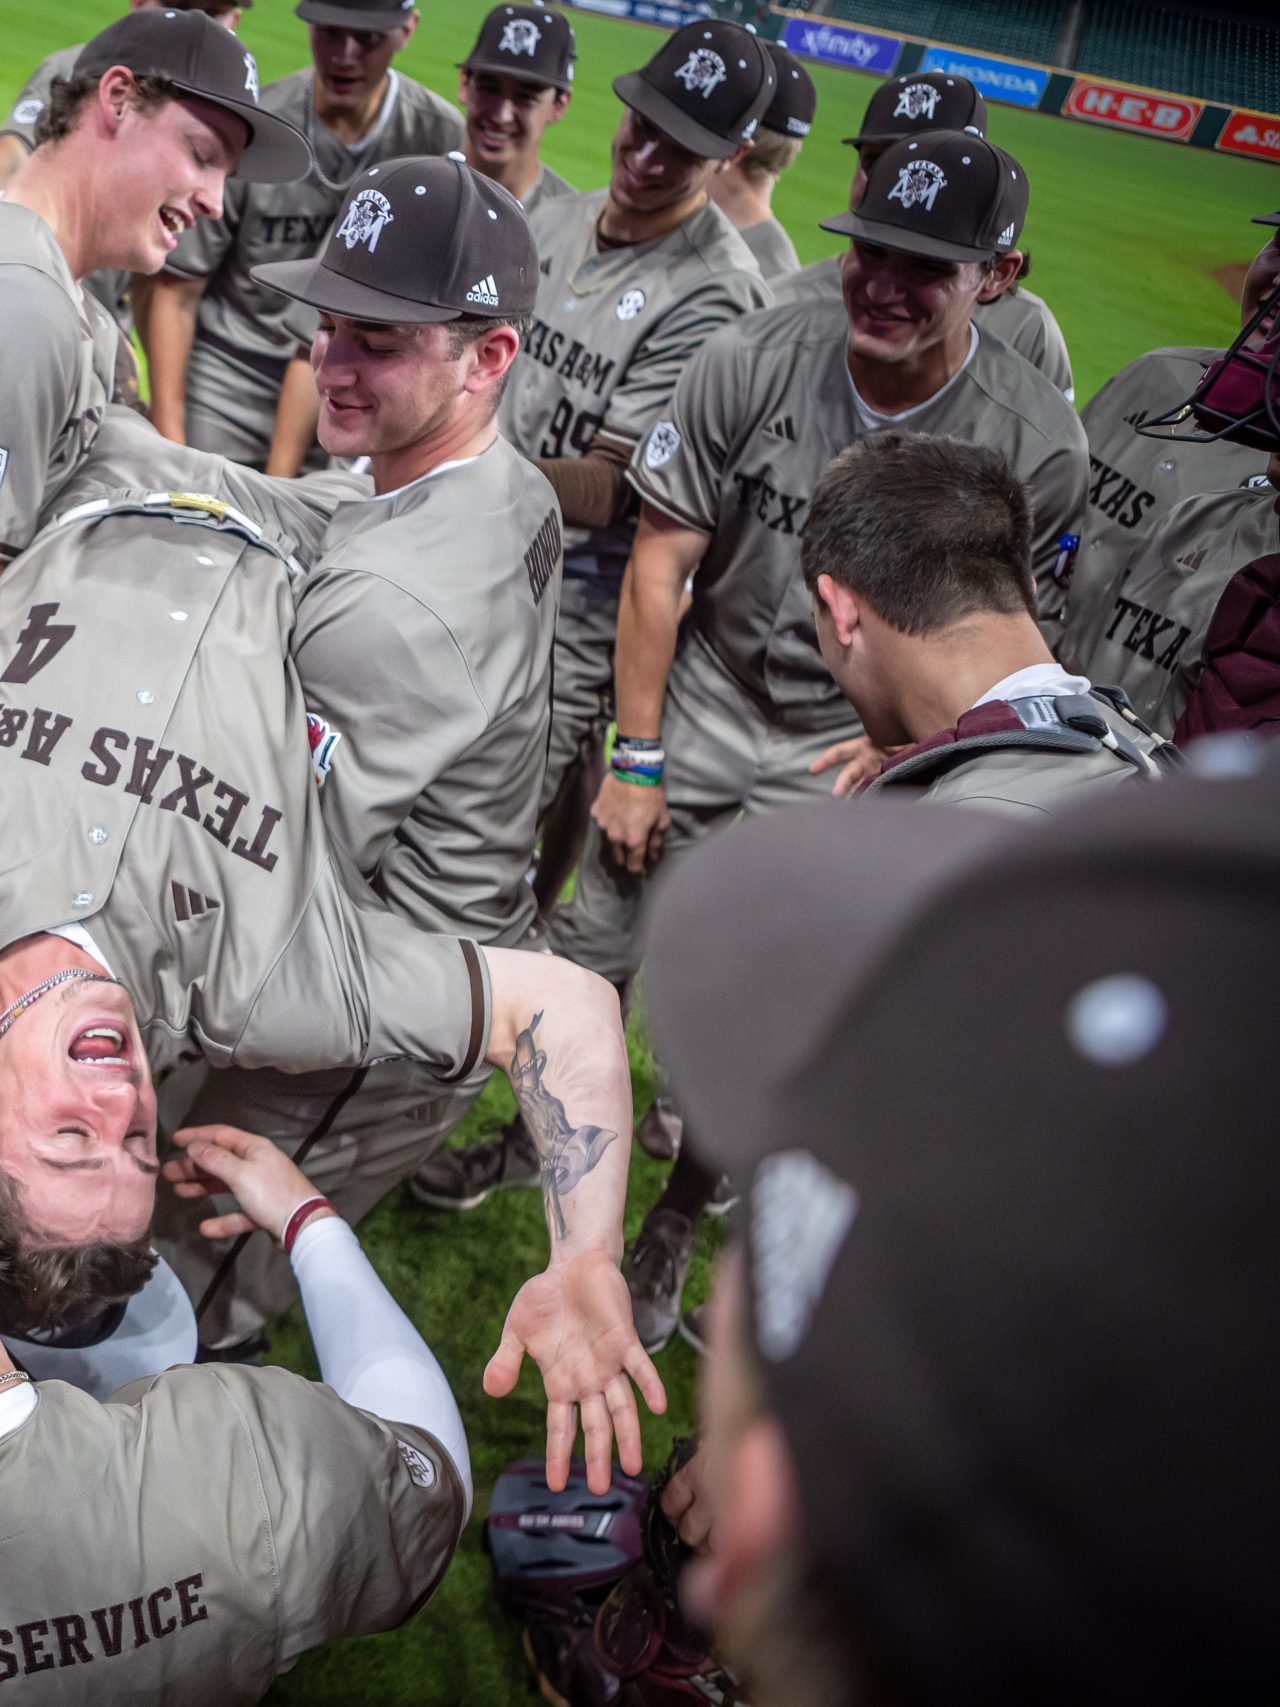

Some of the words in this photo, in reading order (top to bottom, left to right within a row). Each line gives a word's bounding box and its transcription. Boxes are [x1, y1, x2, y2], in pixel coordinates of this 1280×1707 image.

[948, 62, 1038, 94] HONDA
[261, 215, 336, 243] TEX
[466, 291, 499, 307] adidas
[558, 339, 616, 396] A&M
[0, 602, 77, 684] 4
[1106, 597, 1192, 675] TEXA
[81, 727, 283, 873] TEXAS
